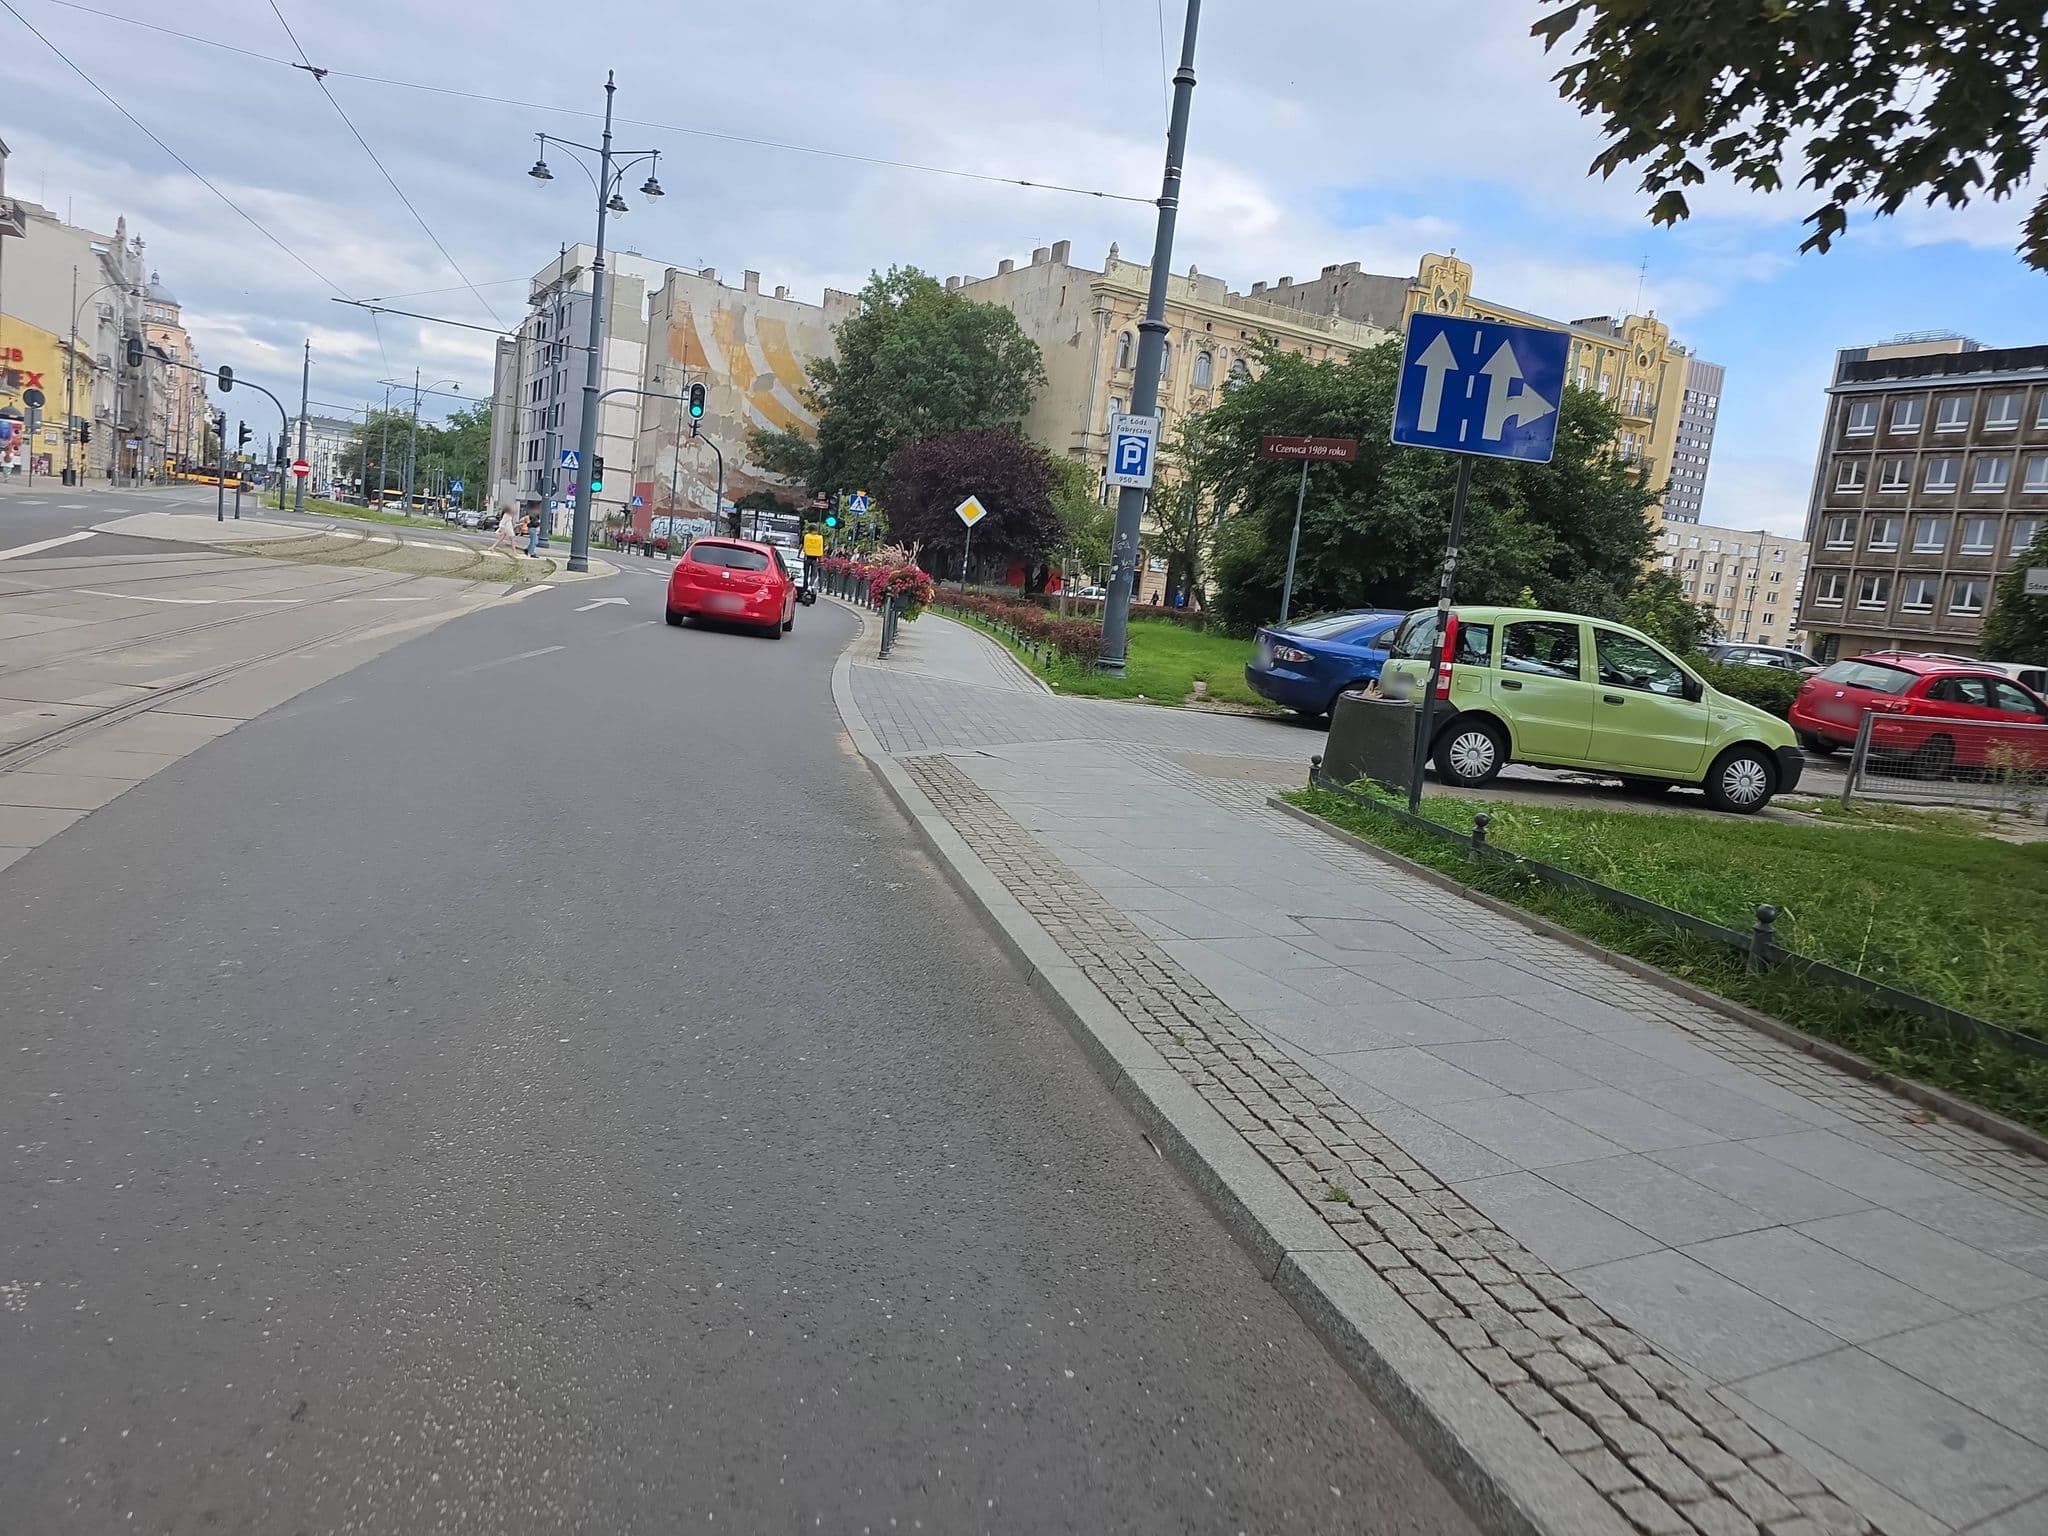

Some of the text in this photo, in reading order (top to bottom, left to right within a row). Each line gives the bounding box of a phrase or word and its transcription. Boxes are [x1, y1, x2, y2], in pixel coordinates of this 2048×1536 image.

[1117, 425, 1152, 435] Fabryczna
[1269, 443, 1347, 457] 4 Czerwca 1989 roku
